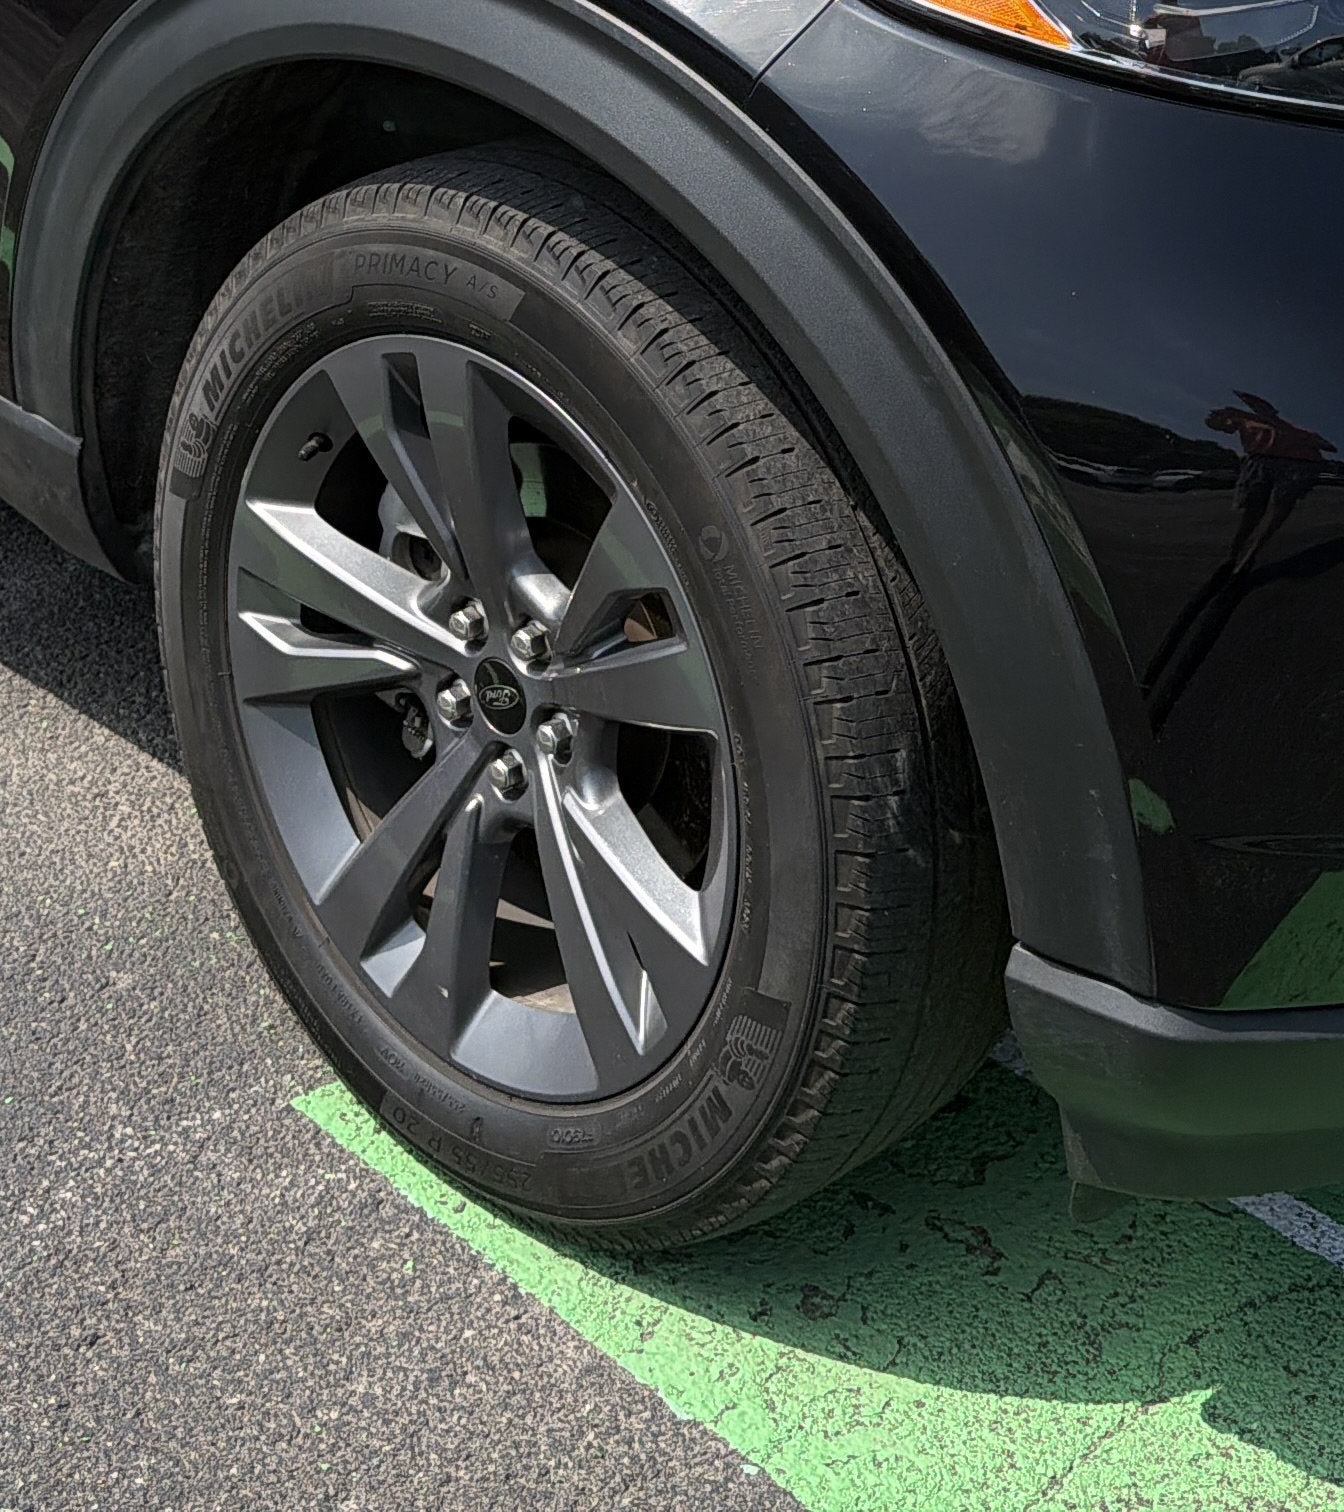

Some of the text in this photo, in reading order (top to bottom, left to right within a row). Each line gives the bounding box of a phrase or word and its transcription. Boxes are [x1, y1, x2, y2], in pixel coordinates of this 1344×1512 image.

[354, 253, 499, 301] PRIMACY A/S
[485, 689, 511, 706] Ford
[392, 1100, 420, 1139] 20
[621, 1084, 736, 1190] MICHE
